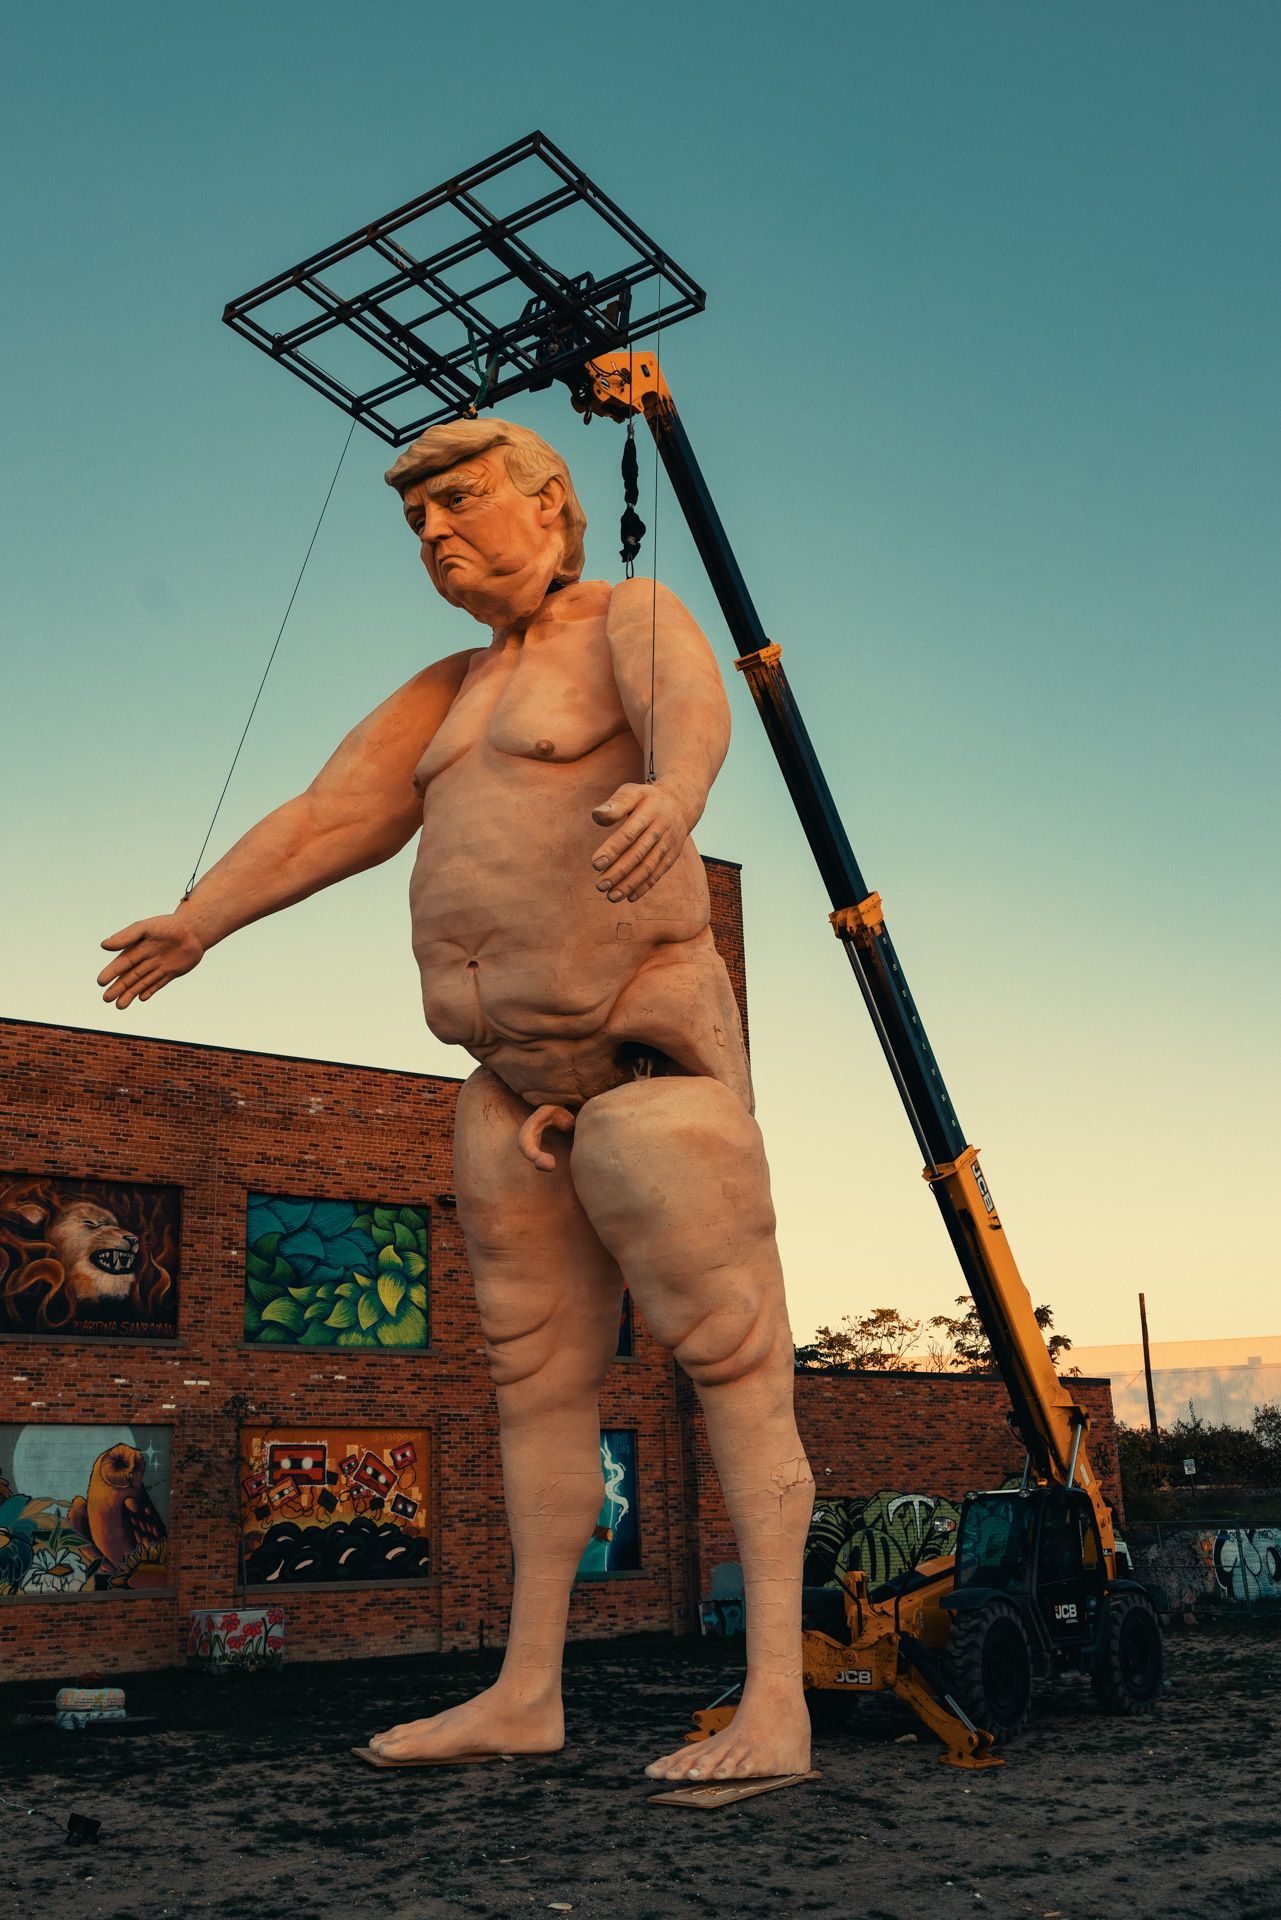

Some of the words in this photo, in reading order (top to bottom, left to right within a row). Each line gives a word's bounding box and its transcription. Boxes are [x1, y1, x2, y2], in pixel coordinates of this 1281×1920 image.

[971, 1160, 994, 1213] JCB
[1052, 1603, 1078, 1619] JCB
[835, 1670, 872, 1684] JCB
